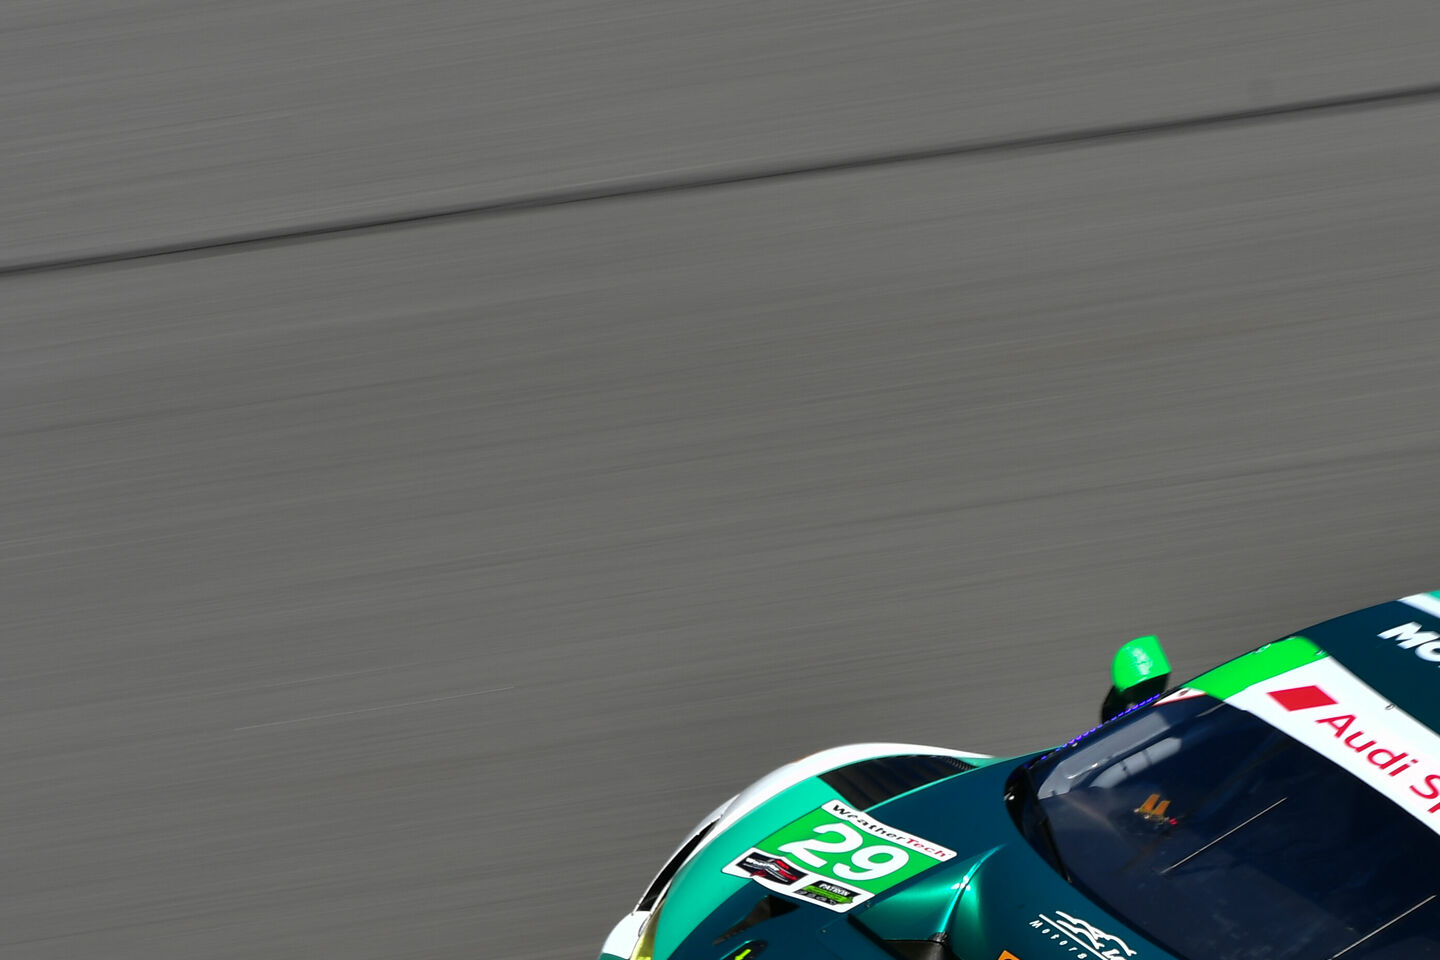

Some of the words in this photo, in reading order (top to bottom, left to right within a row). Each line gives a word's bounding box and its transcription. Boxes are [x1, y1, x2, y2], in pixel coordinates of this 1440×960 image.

[1315, 713, 1418, 778] Audi
[778, 822, 909, 881] 29
[832, 803, 947, 859] WeatherTech
